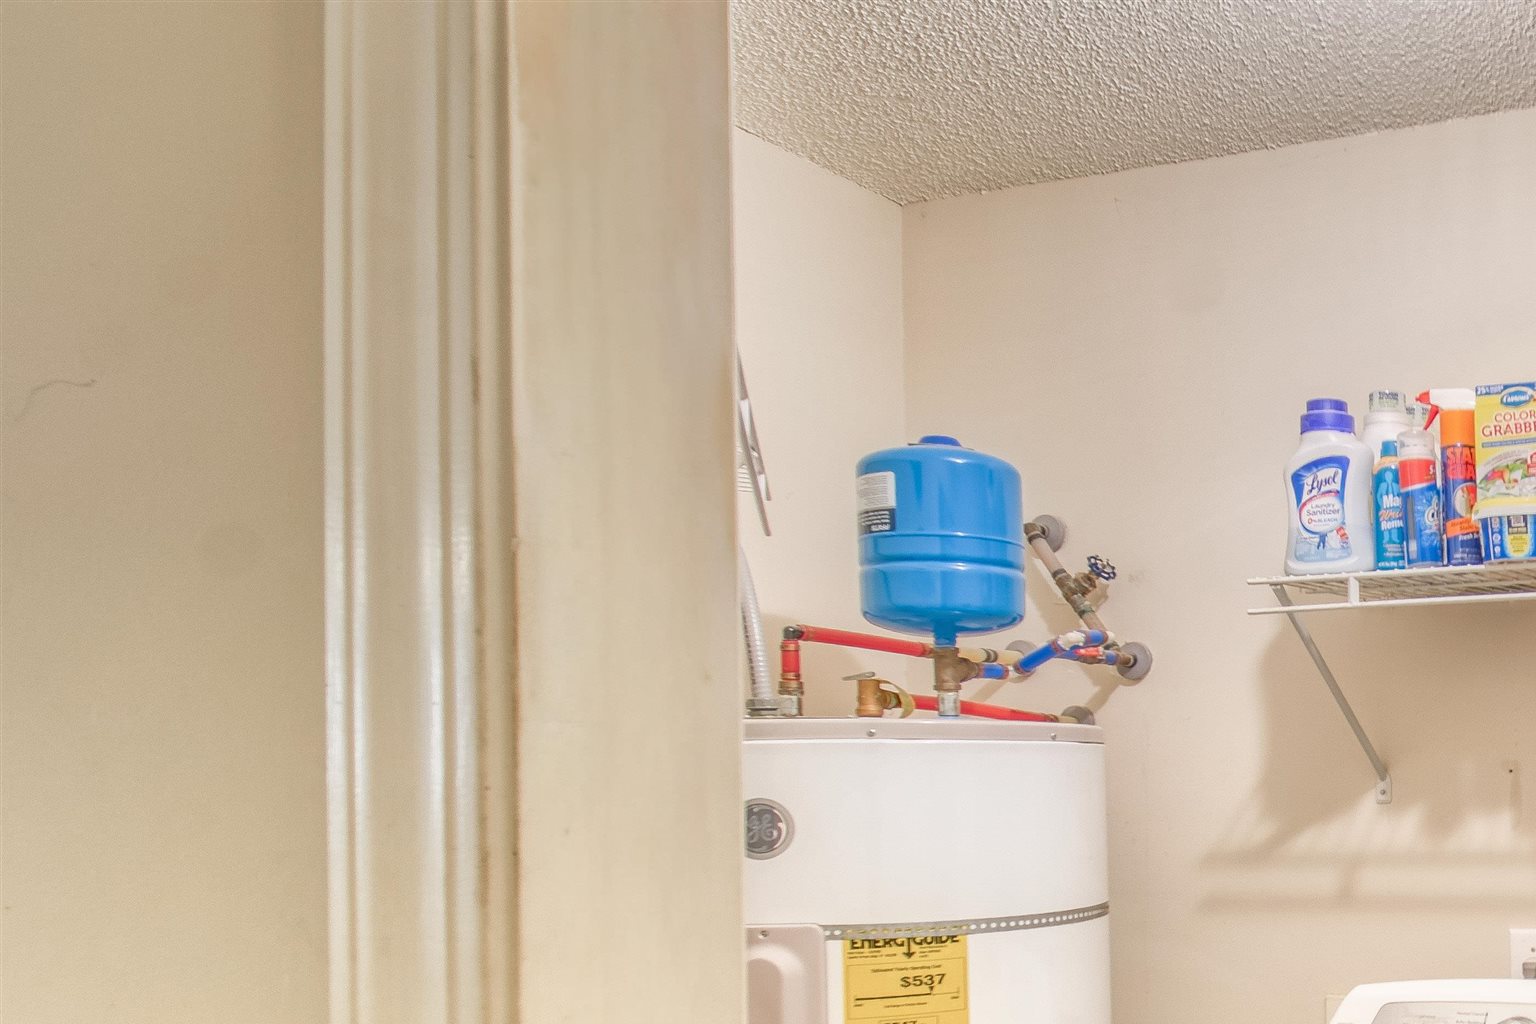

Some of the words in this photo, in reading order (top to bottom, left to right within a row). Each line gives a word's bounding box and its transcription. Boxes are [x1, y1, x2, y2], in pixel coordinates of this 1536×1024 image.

[1494, 409, 1536, 423] COLOR
[1306, 470, 1339, 495] Lysol
[1306, 506, 1340, 517] Sanitizer
[900, 973, 946, 988] $537
